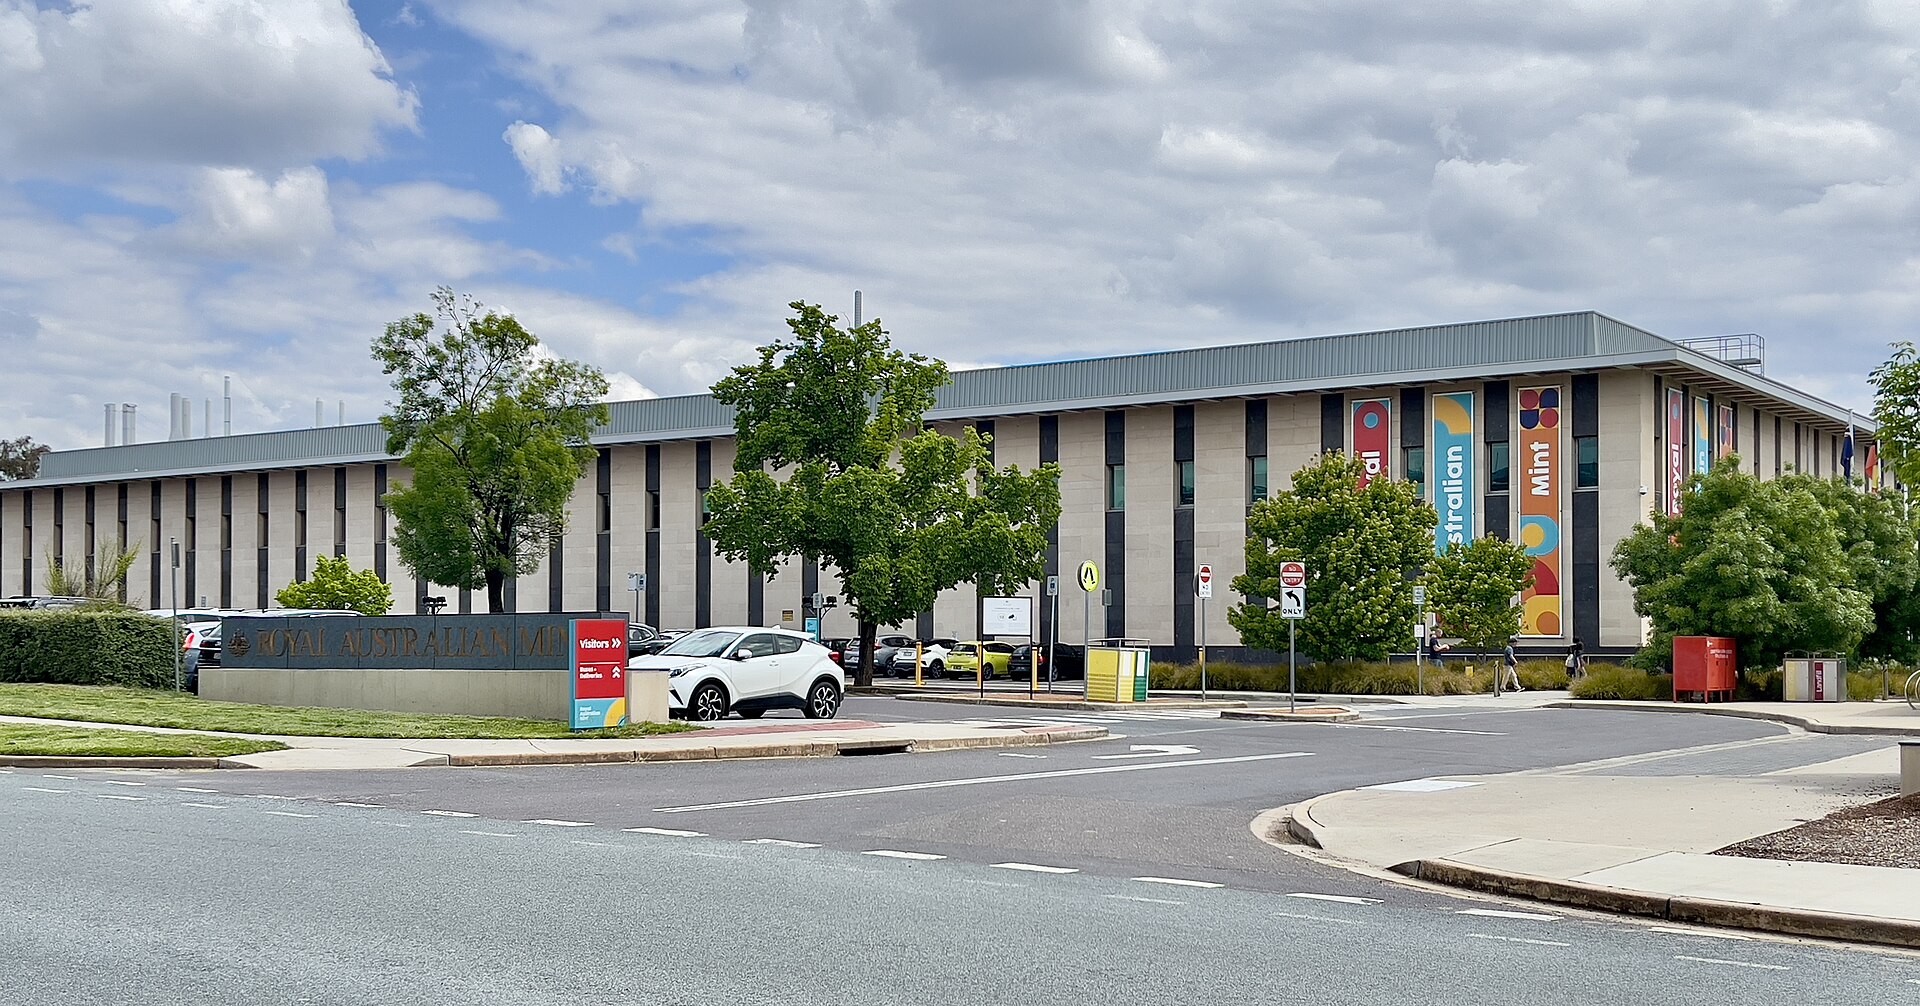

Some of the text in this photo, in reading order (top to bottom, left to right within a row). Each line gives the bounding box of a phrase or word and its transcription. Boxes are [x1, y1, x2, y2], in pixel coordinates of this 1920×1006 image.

[1528, 441, 1550, 496] Mint
[1442, 445, 1464, 545] stralian
[256, 625, 570, 659] ROYAL AUSTRALIAN MIN
[580, 639, 609, 649] Visitors
